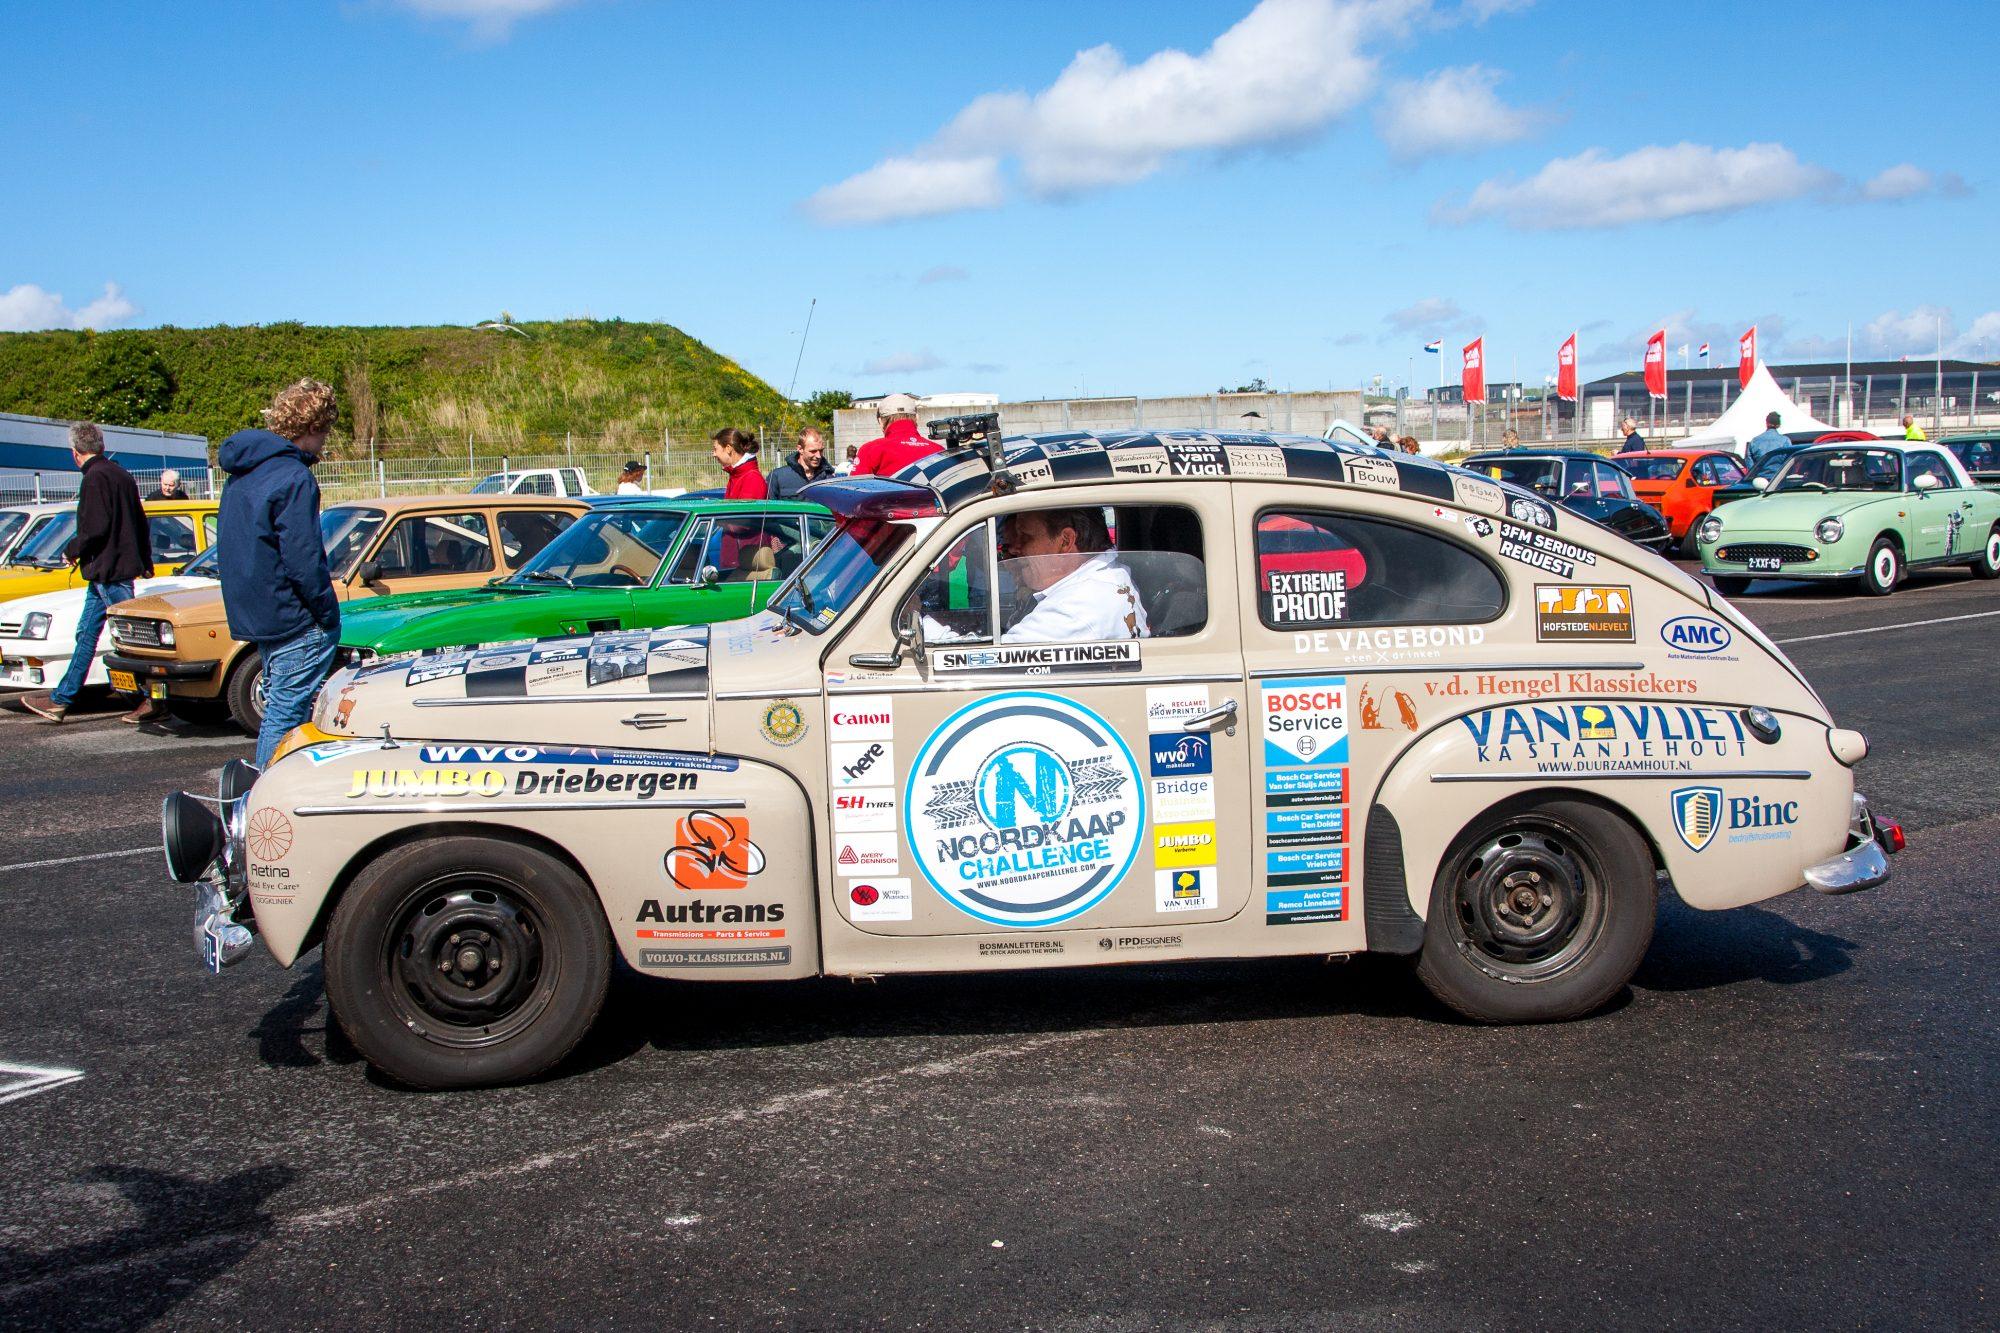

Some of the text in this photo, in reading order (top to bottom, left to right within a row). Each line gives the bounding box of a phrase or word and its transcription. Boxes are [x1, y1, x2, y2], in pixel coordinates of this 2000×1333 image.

[1168, 445, 1220, 453] Hans
[1178, 453, 1216, 462] van
[1174, 462, 1225, 476] Vugt
[1358, 470, 1397, 485] Bouw
[1500, 524, 1596, 566] 3FM SERIOUS
[1501, 542, 1574, 577] REQUEST
[1271, 573, 1345, 594] EXTREME
[1273, 592, 1346, 622] PROOF
[1294, 626, 1485, 653] DE VAGEBOND
[1671, 625, 1724, 645] AMC
[1392, 649, 1441, 660] drinken
[1024, 666, 1051, 676] .COM
[1424, 672, 1698, 698] v.d. Hengel Klassiekers
[1268, 692, 1342, 713] BOSCH
[833, 713, 891, 726] Canon
[1268, 713, 1343, 732] Service
[1460, 705, 1746, 746] VAN VLIET
[426, 747, 538, 762] WVO
[1478, 741, 1746, 763] KASTANJEHOUT
[612, 758, 673, 768] nieuwbouw
[842, 743, 885, 779] here
[1537, 761, 1693, 772] WWW.DUURZAAMHOUT.NL
[346, 768, 698, 800] JUMBO Driebergen
[1276, 773, 1299, 782] Bosch
[1314, 771, 1341, 779] Service
[1156, 780, 1208, 795] Bridge
[866, 801, 894, 809] TYRES
[1728, 795, 1799, 829] Binc
[1277, 812, 1341, 822] Bosch Car Service
[1317, 820, 1341, 828] Dolder
[936, 810, 1126, 863] NOORDKAAP
[1159, 834, 1213, 849] JUMBO
[860, 857, 898, 865] DENNISON
[960, 838, 1112, 880] CHALLENGE
[1278, 852, 1341, 862] Bosch Car Service
[251, 863, 290, 878] Retina
[976, 863, 1097, 889] WWW.NOORDKAAPCHALLENGE.COM
[262, 883, 275, 891] Eye
[1164, 900, 1181, 908] VAN
[1185, 897, 1206, 906] VLIET
[1304, 892, 1321, 900] Auto
[635, 899, 785, 923] Autrans
[1278, 901, 1303, 909] Remco
[653, 930, 704, 939] Transmissions
[744, 930, 771, 938] Service
[979, 941, 1064, 950] BOSMANLETTERS.NL
[645, 951, 786, 963] VOLVO-KLASSIEKERS.NL
